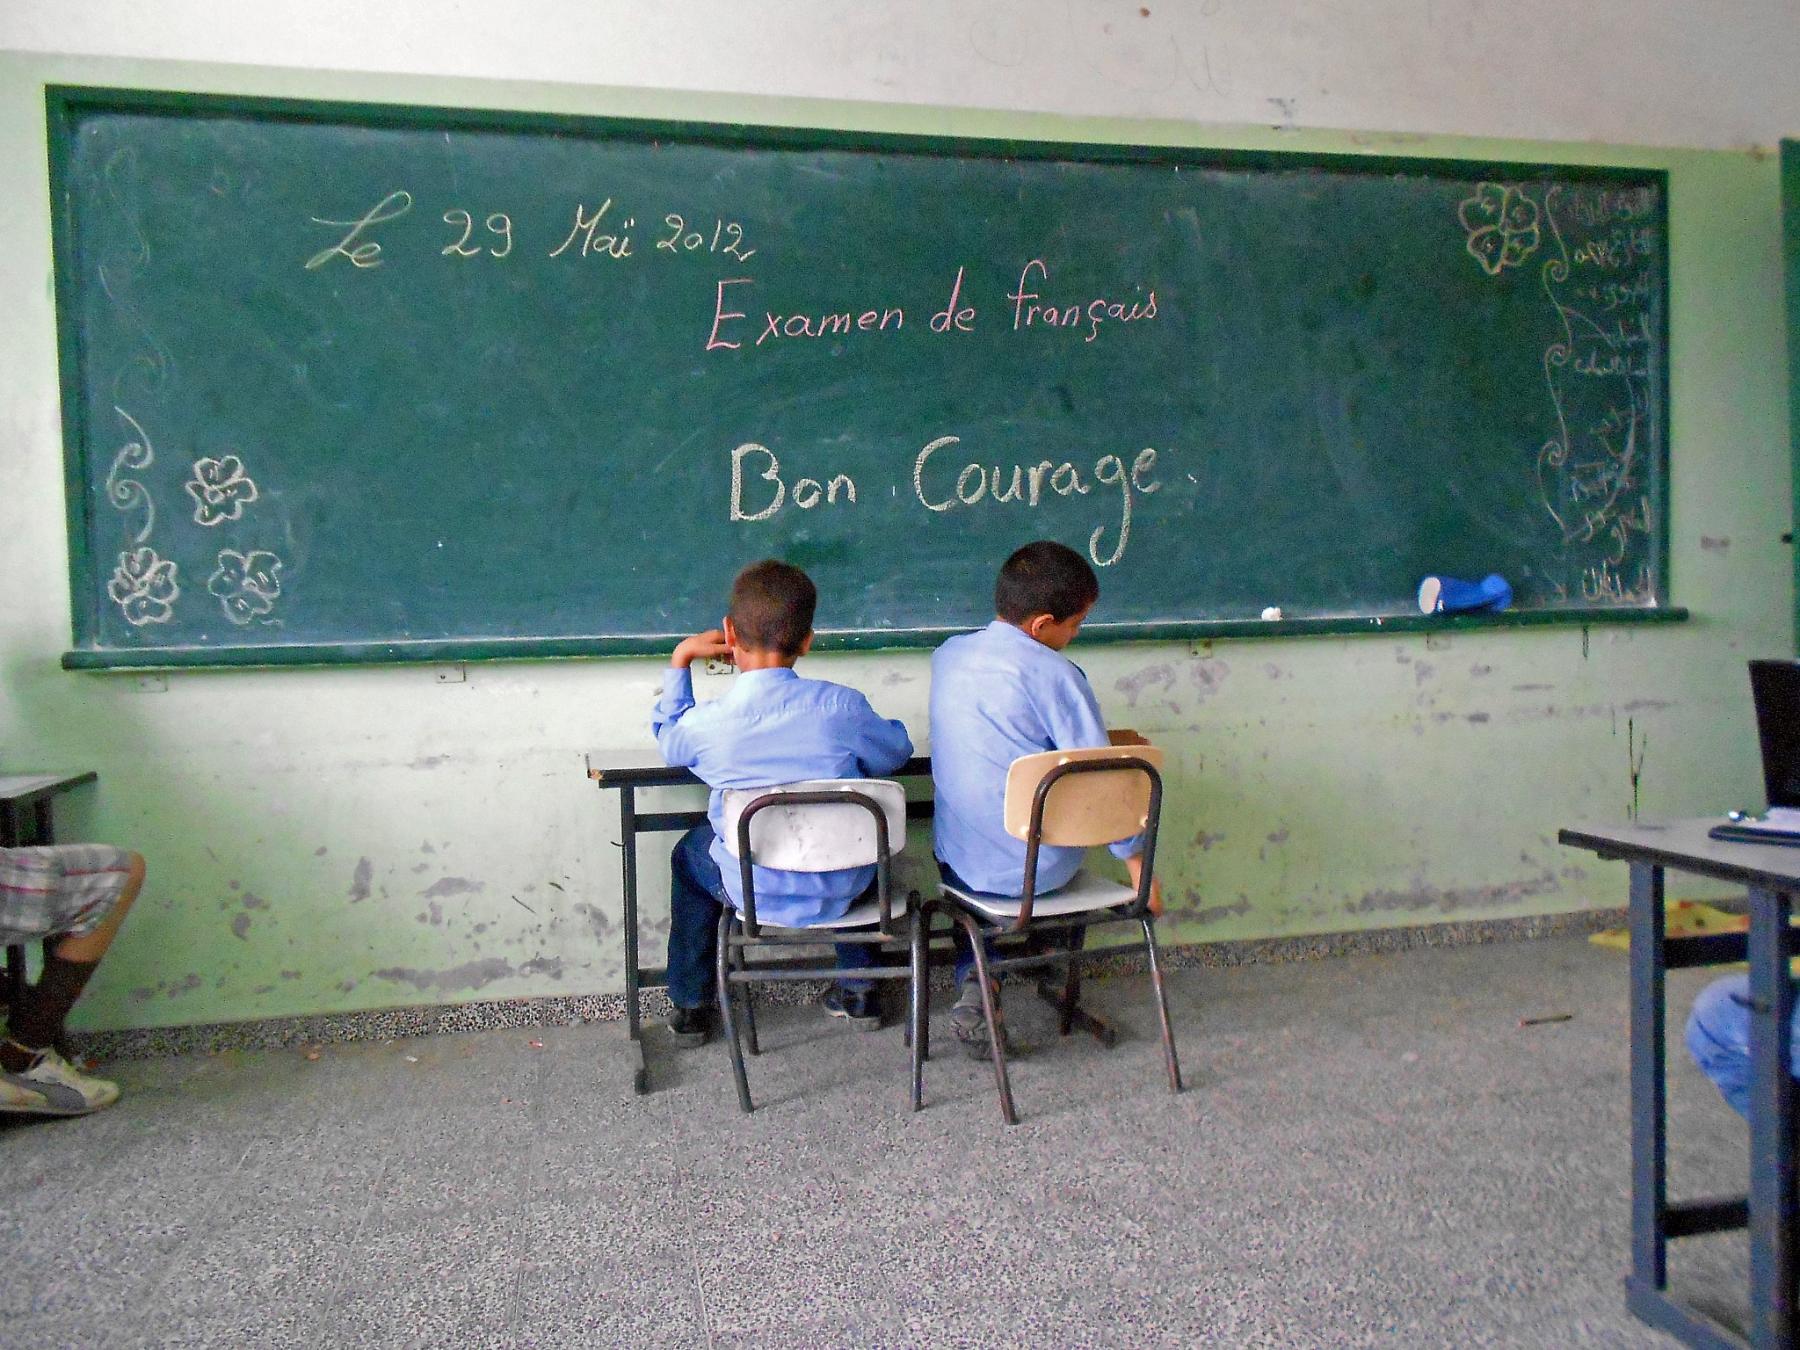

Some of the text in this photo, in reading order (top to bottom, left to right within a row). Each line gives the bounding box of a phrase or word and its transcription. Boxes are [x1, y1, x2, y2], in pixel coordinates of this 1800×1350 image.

[304, 190, 412, 269] Le
[442, 208, 513, 258] 29
[705, 259, 1158, 351] Examen de français
[729, 435, 1161, 568] Bon Courage
